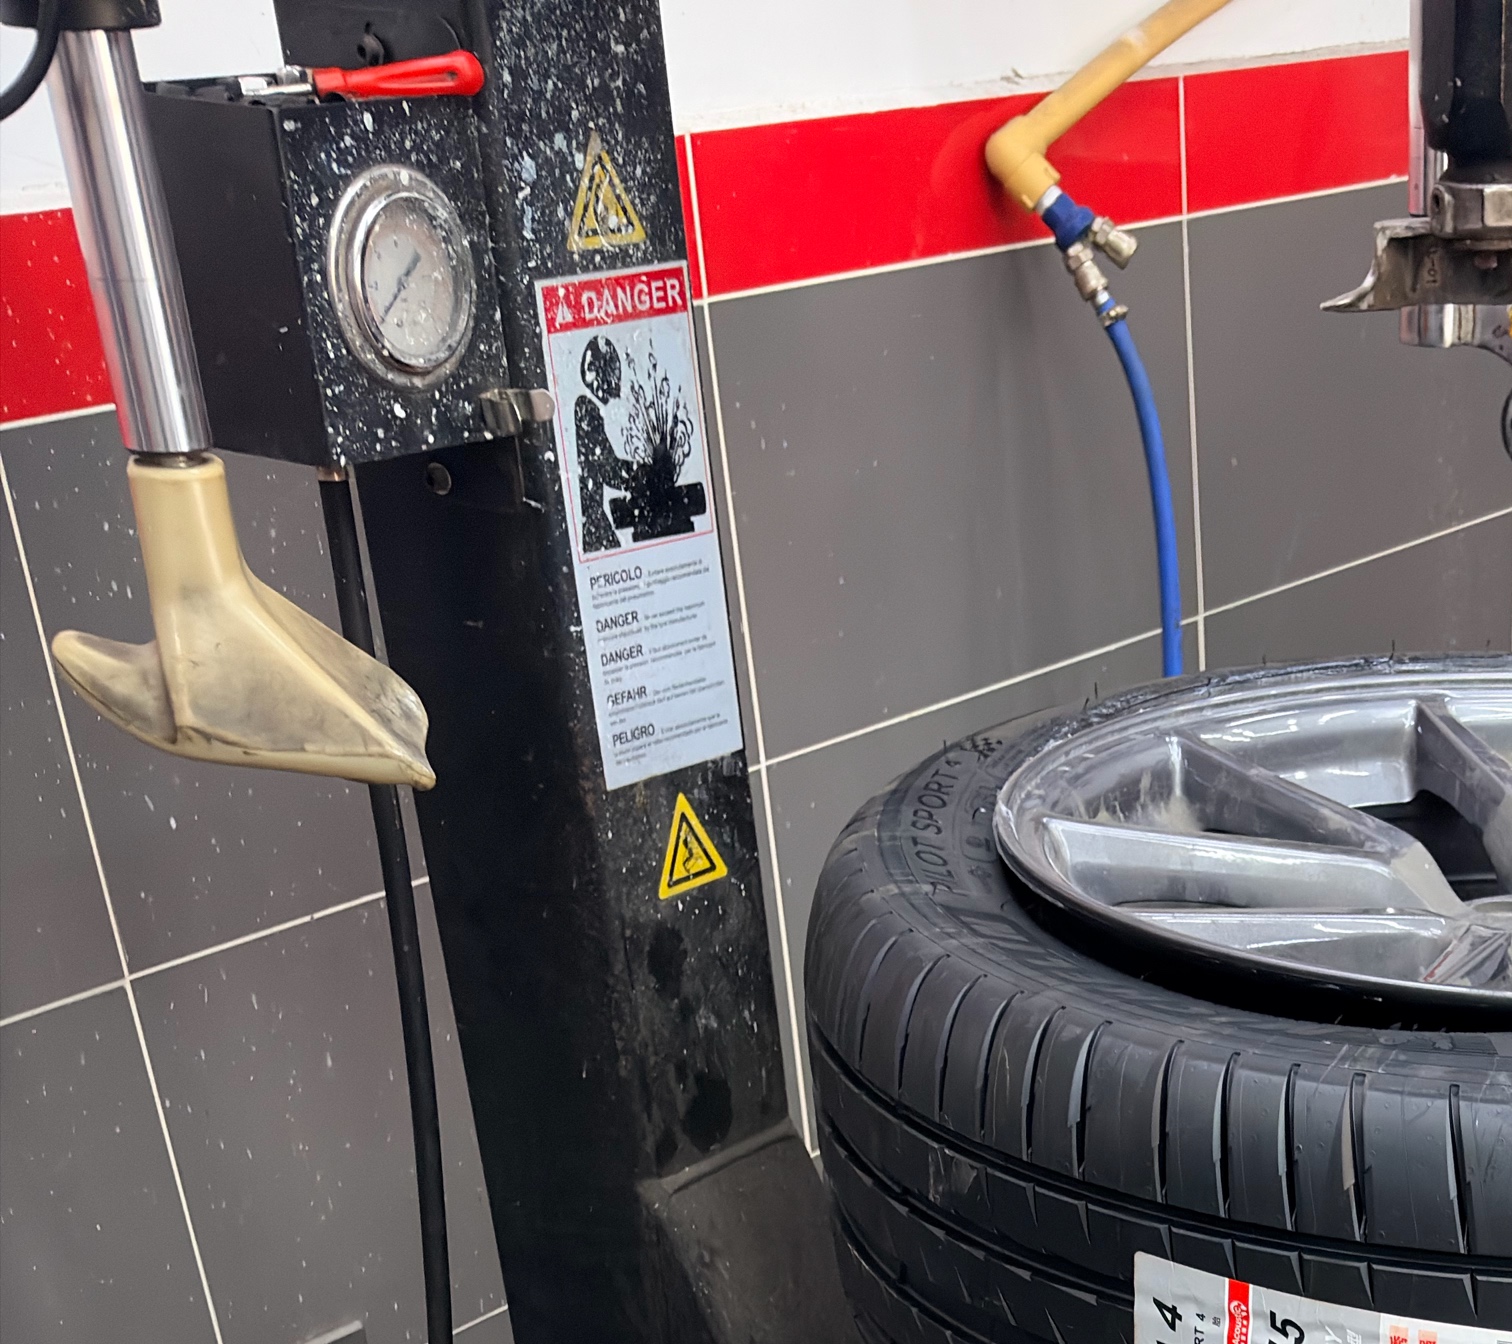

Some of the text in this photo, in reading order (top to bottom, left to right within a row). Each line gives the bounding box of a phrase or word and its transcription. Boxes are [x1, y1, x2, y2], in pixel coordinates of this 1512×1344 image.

[581, 279, 683, 320] DANGER
[590, 566, 643, 590] PERICOLO
[596, 611, 639, 633] DANGER
[601, 644, 644, 667] DANGER
[607, 685, 647, 707] GEFAHR
[612, 723, 656, 747] PELIGRO
[910, 768, 959, 835] SPORT
[915, 836, 968, 897] PILOT
[1152, 1297, 1183, 1332] 4
[1195, 1312, 1206, 1322] 4
